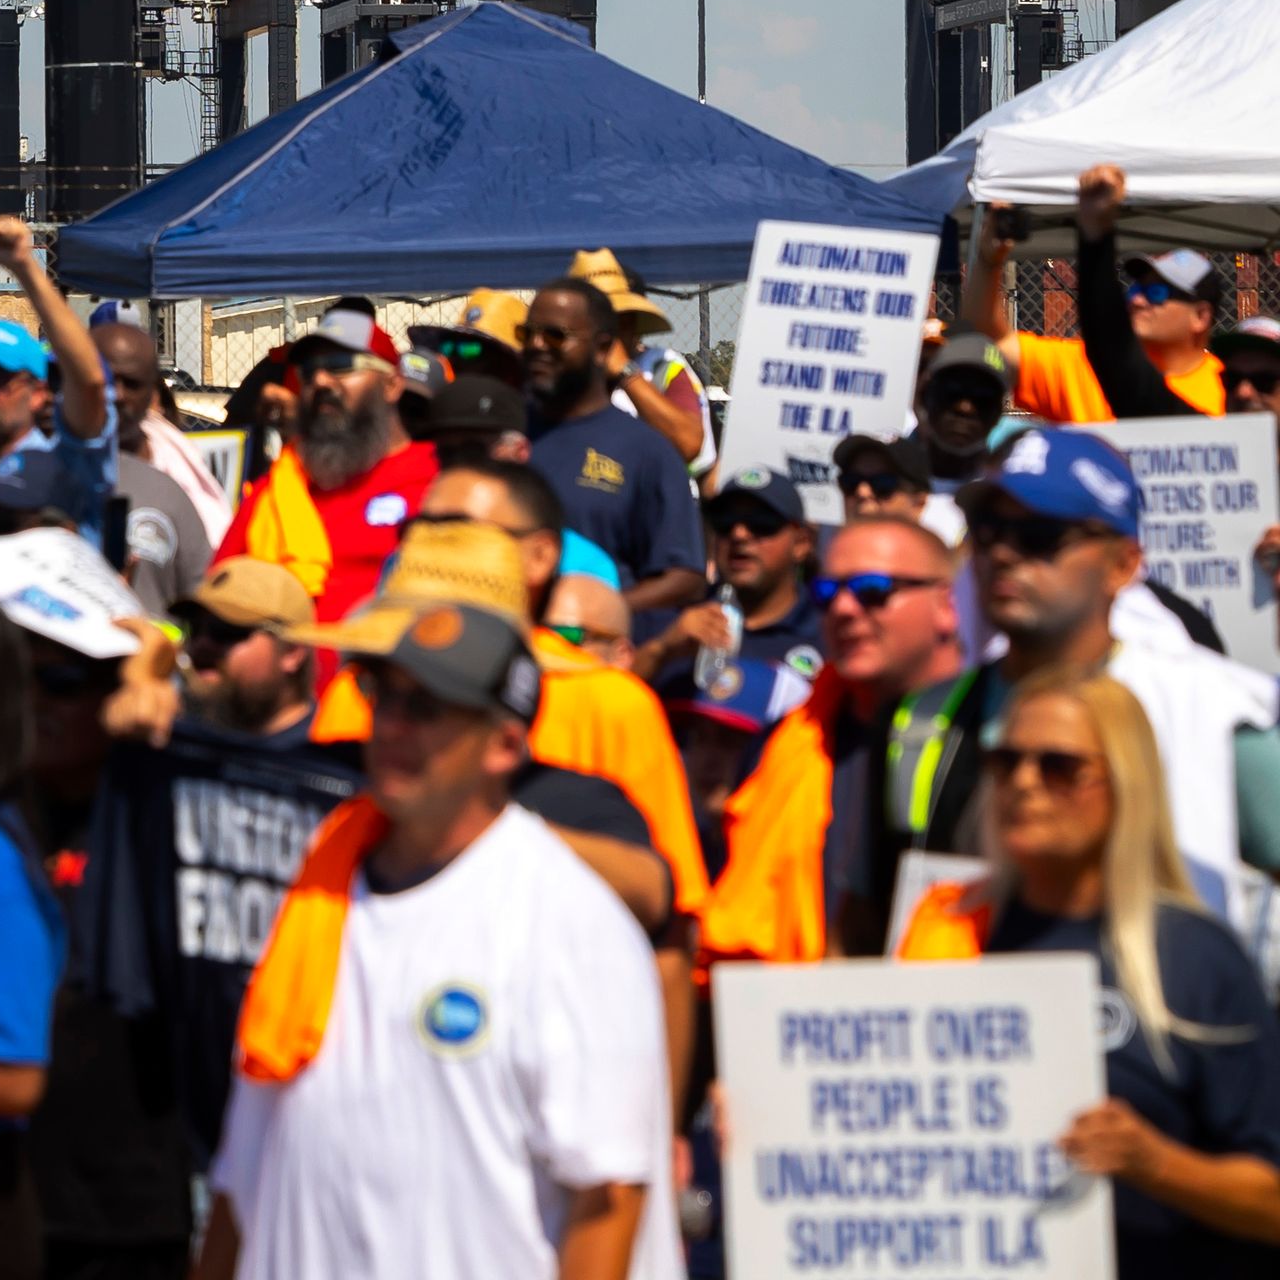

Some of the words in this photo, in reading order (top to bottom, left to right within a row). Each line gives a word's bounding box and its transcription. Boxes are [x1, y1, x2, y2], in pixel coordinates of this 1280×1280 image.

[778, 241, 909, 278] AUTOMATION
[759, 279, 866, 314] THREATENS
[874, 290, 915, 318] OUR
[758, 360, 825, 392] STAND
[832, 369, 886, 398] WITH
[780, 402, 812, 431] THE
[818, 406, 853, 435] ILA
[1127, 444, 1239, 476] TOMATION
[1211, 479, 1260, 512] OUR
[1140, 521, 1215, 552] UTURE:
[1182, 559, 1240, 589] WITH
[778, 1007, 914, 1066] PROFIT
[926, 1004, 1034, 1062] OVER
[811, 1075, 958, 1135] PEOPLE
[969, 1073, 1008, 1129] IS
[787, 1212, 961, 1271] SUPPORT
[980, 1210, 1046, 1271] ILA
